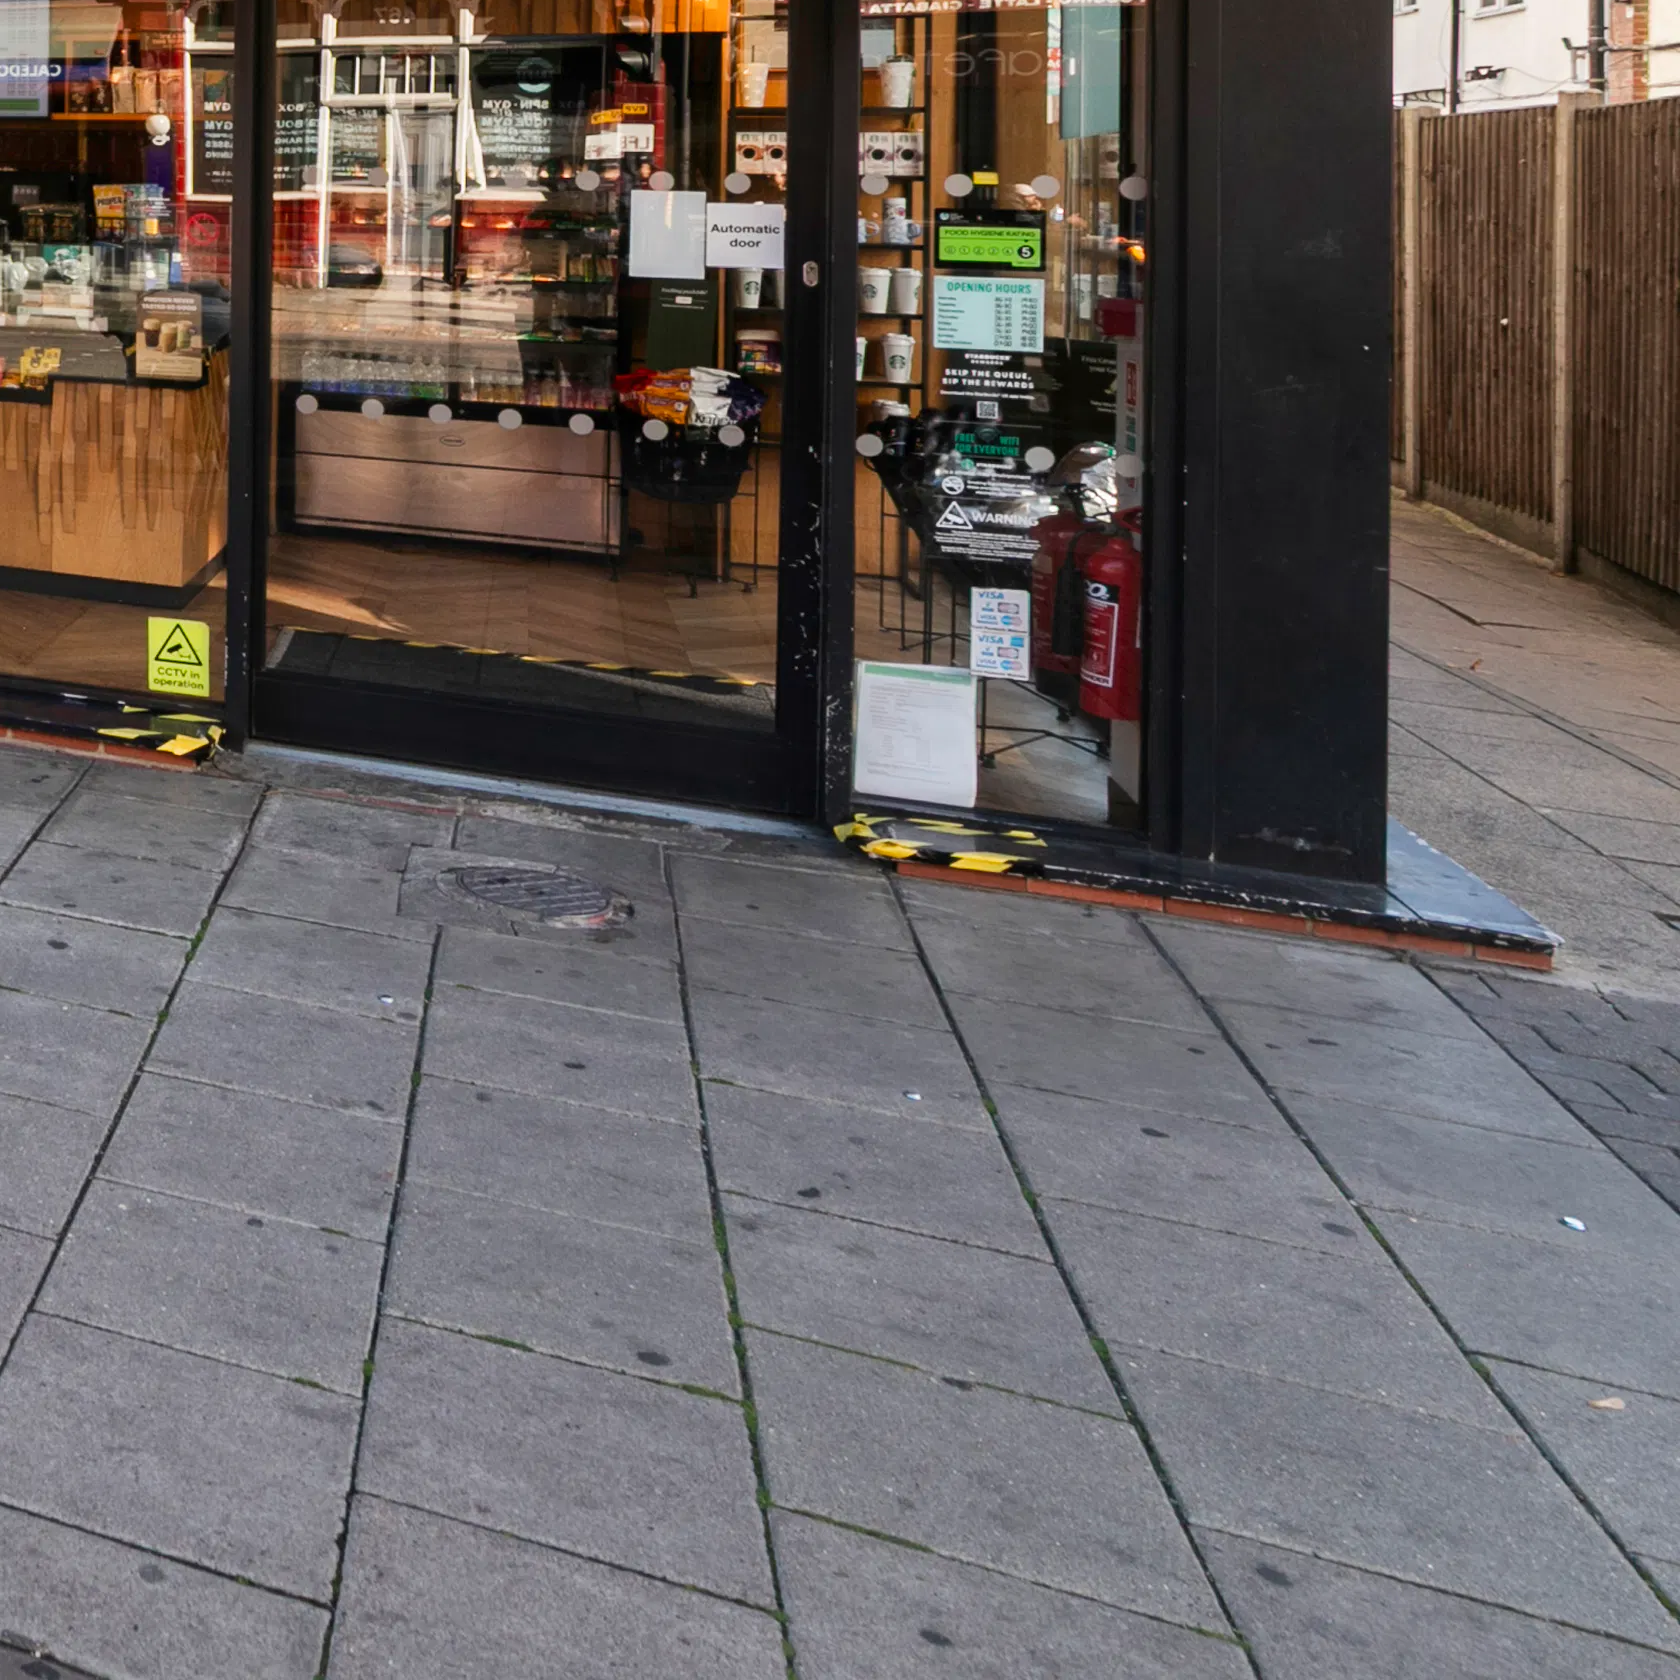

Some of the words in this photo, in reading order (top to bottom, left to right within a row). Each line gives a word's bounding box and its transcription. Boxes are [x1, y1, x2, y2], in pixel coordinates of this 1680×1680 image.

[710, 222, 781, 234] Automatic
[729, 236, 762, 250] door
[947, 282, 993, 292] OPENING
[995, 283, 1032, 294] HOURS
[945, 368, 969, 376] SKIP
[971, 369, 991, 377] THE
[993, 370, 1032, 380] QUEUE,
[942, 377, 959, 385] SIP
[962, 378, 981, 386] THE
[983, 379, 1034, 389] REWARDS
[955, 433, 975, 443] FREE
[1000, 436, 1020, 446] WIFI
[955, 443, 972, 453] FOR
[973, 444, 1020, 456] EVERYONE
[971, 511, 1039, 527] WARNING
[978, 590, 1004, 600] VISA
[978, 635, 1004, 645] VISA
[157, 666, 188, 678] CCTV
[190, 670, 200, 679] in
[153, 678, 204, 690] operation
